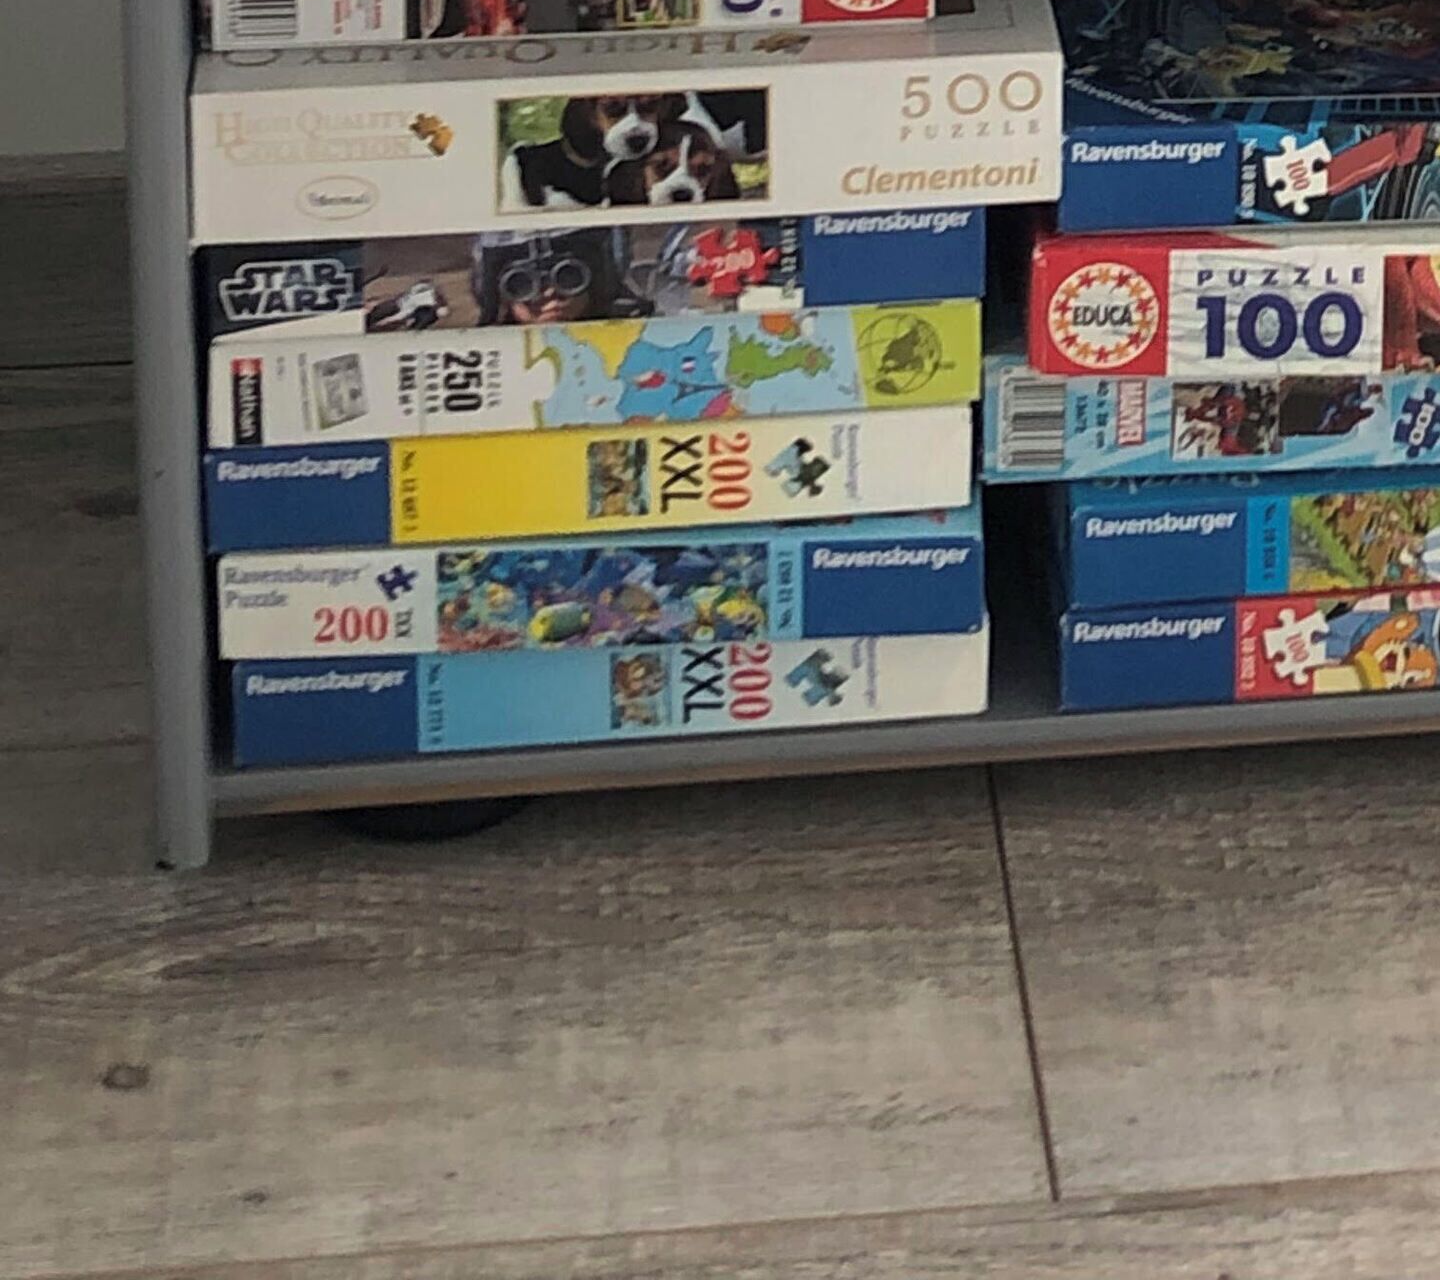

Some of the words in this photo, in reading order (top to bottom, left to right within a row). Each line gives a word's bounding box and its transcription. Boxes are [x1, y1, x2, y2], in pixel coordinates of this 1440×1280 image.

[900, 69, 1044, 120] 500
[899, 117, 1041, 143] PUZZLE
[1071, 139, 1227, 165] Ravensburger
[841, 156, 1041, 196] Clementoni
[1285, 159, 1312, 192] 100
[813, 210, 972, 236] Ravensburger
[228, 263, 347, 291] STAR
[1197, 265, 1367, 287] PUZZLE
[229, 288, 347, 316] WARS
[1072, 303, 1134, 328] EDUCA
[1196, 291, 1365, 361] 100
[442, 348, 485, 414] 250
[235, 374, 261, 439] Nathan
[1119, 381, 1145, 443] MARVEL
[1408, 402, 1435, 446] 100
[217, 455, 382, 482] Ravensburger
[659, 434, 703, 515] XXL
[707, 431, 752, 512] 200
[1084, 511, 1238, 539] Ravensburger
[812, 545, 972, 572] Ravensburger
[313, 604, 390, 644] 200
[1071, 615, 1226, 644] Ravensburger
[1284, 633, 1311, 666] 100
[245, 668, 409, 697] Ravensburger
[681, 645, 725, 725] XXL
[728, 642, 773, 721] 200
